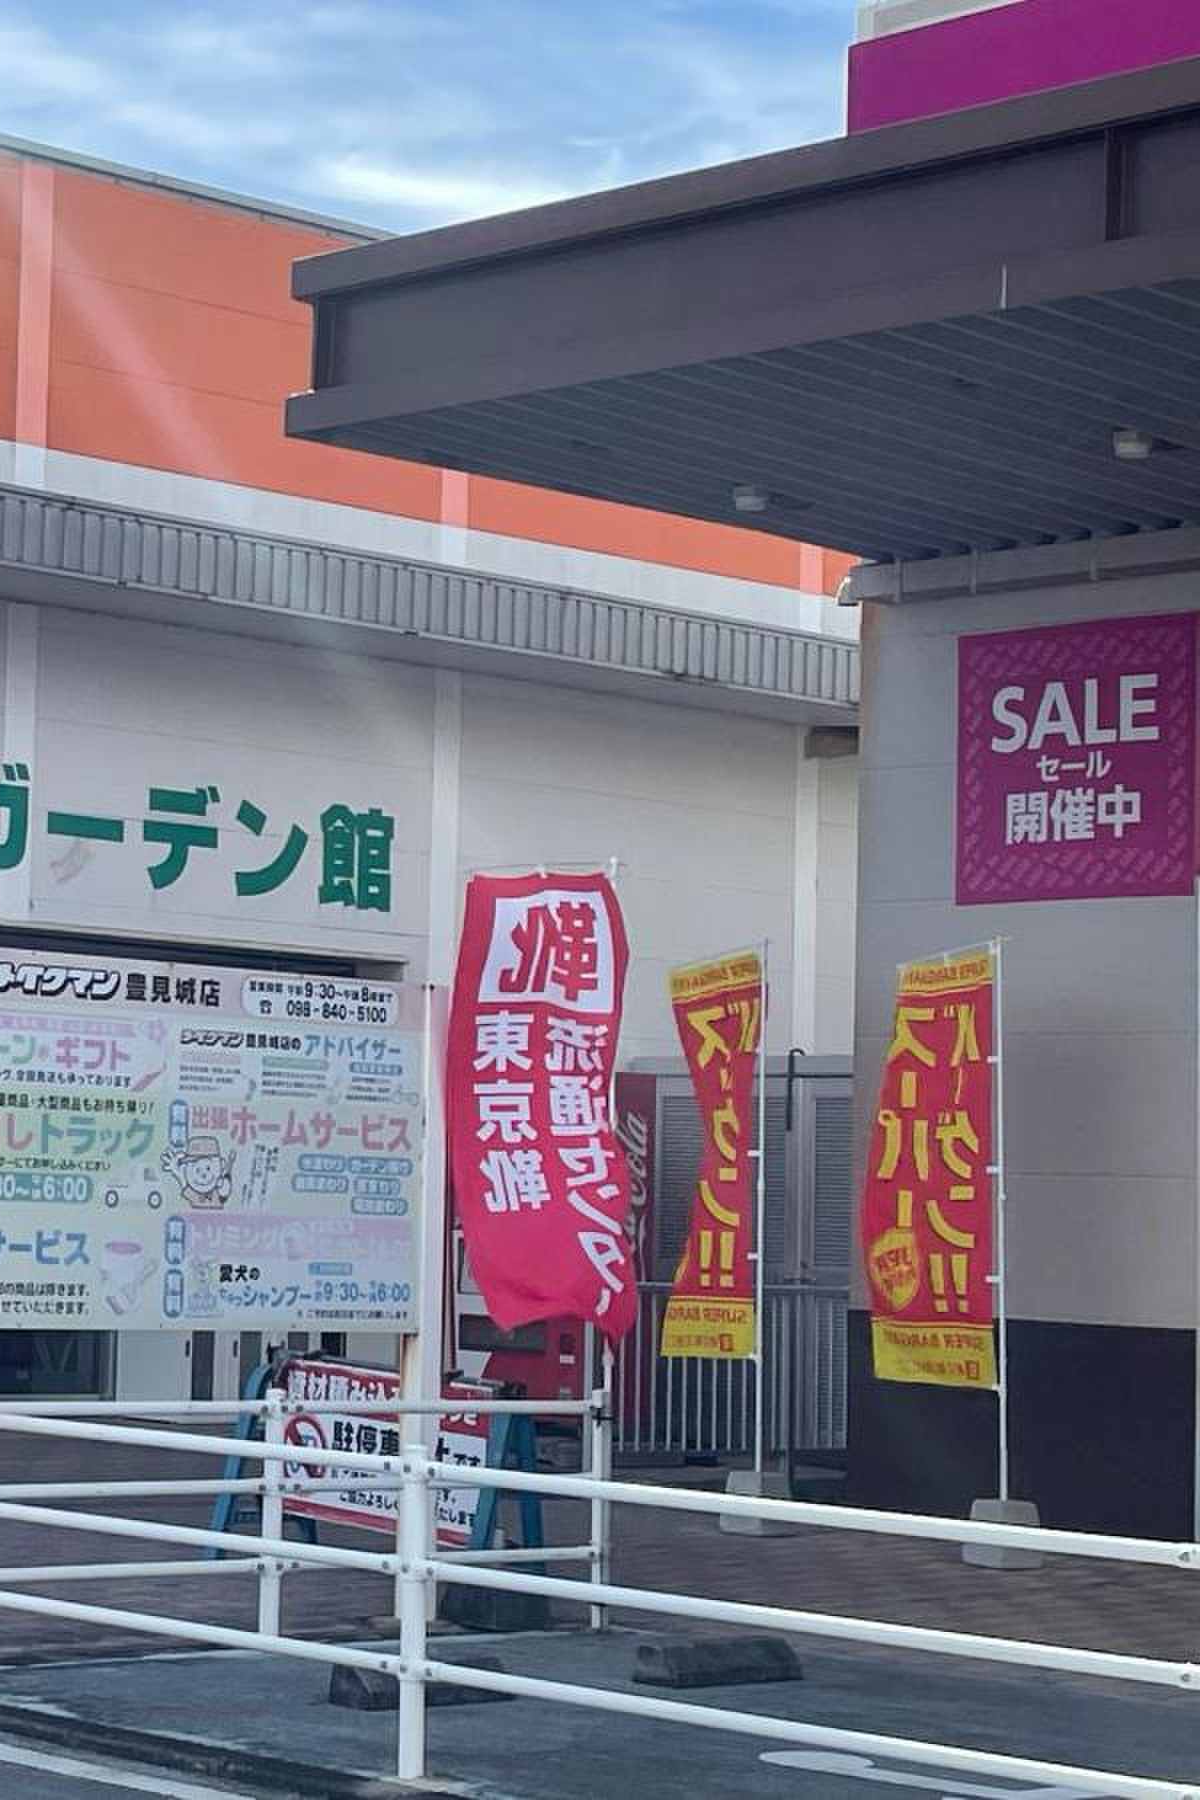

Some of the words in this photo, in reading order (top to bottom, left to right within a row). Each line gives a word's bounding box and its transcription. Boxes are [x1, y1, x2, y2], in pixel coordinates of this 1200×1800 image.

[991, 673, 1160, 753] SALE
[1036, 750, 1112, 782] セール
[1005, 784, 1142, 845] 開催中
[219, 1264, 261, 1283] 愛犬の
